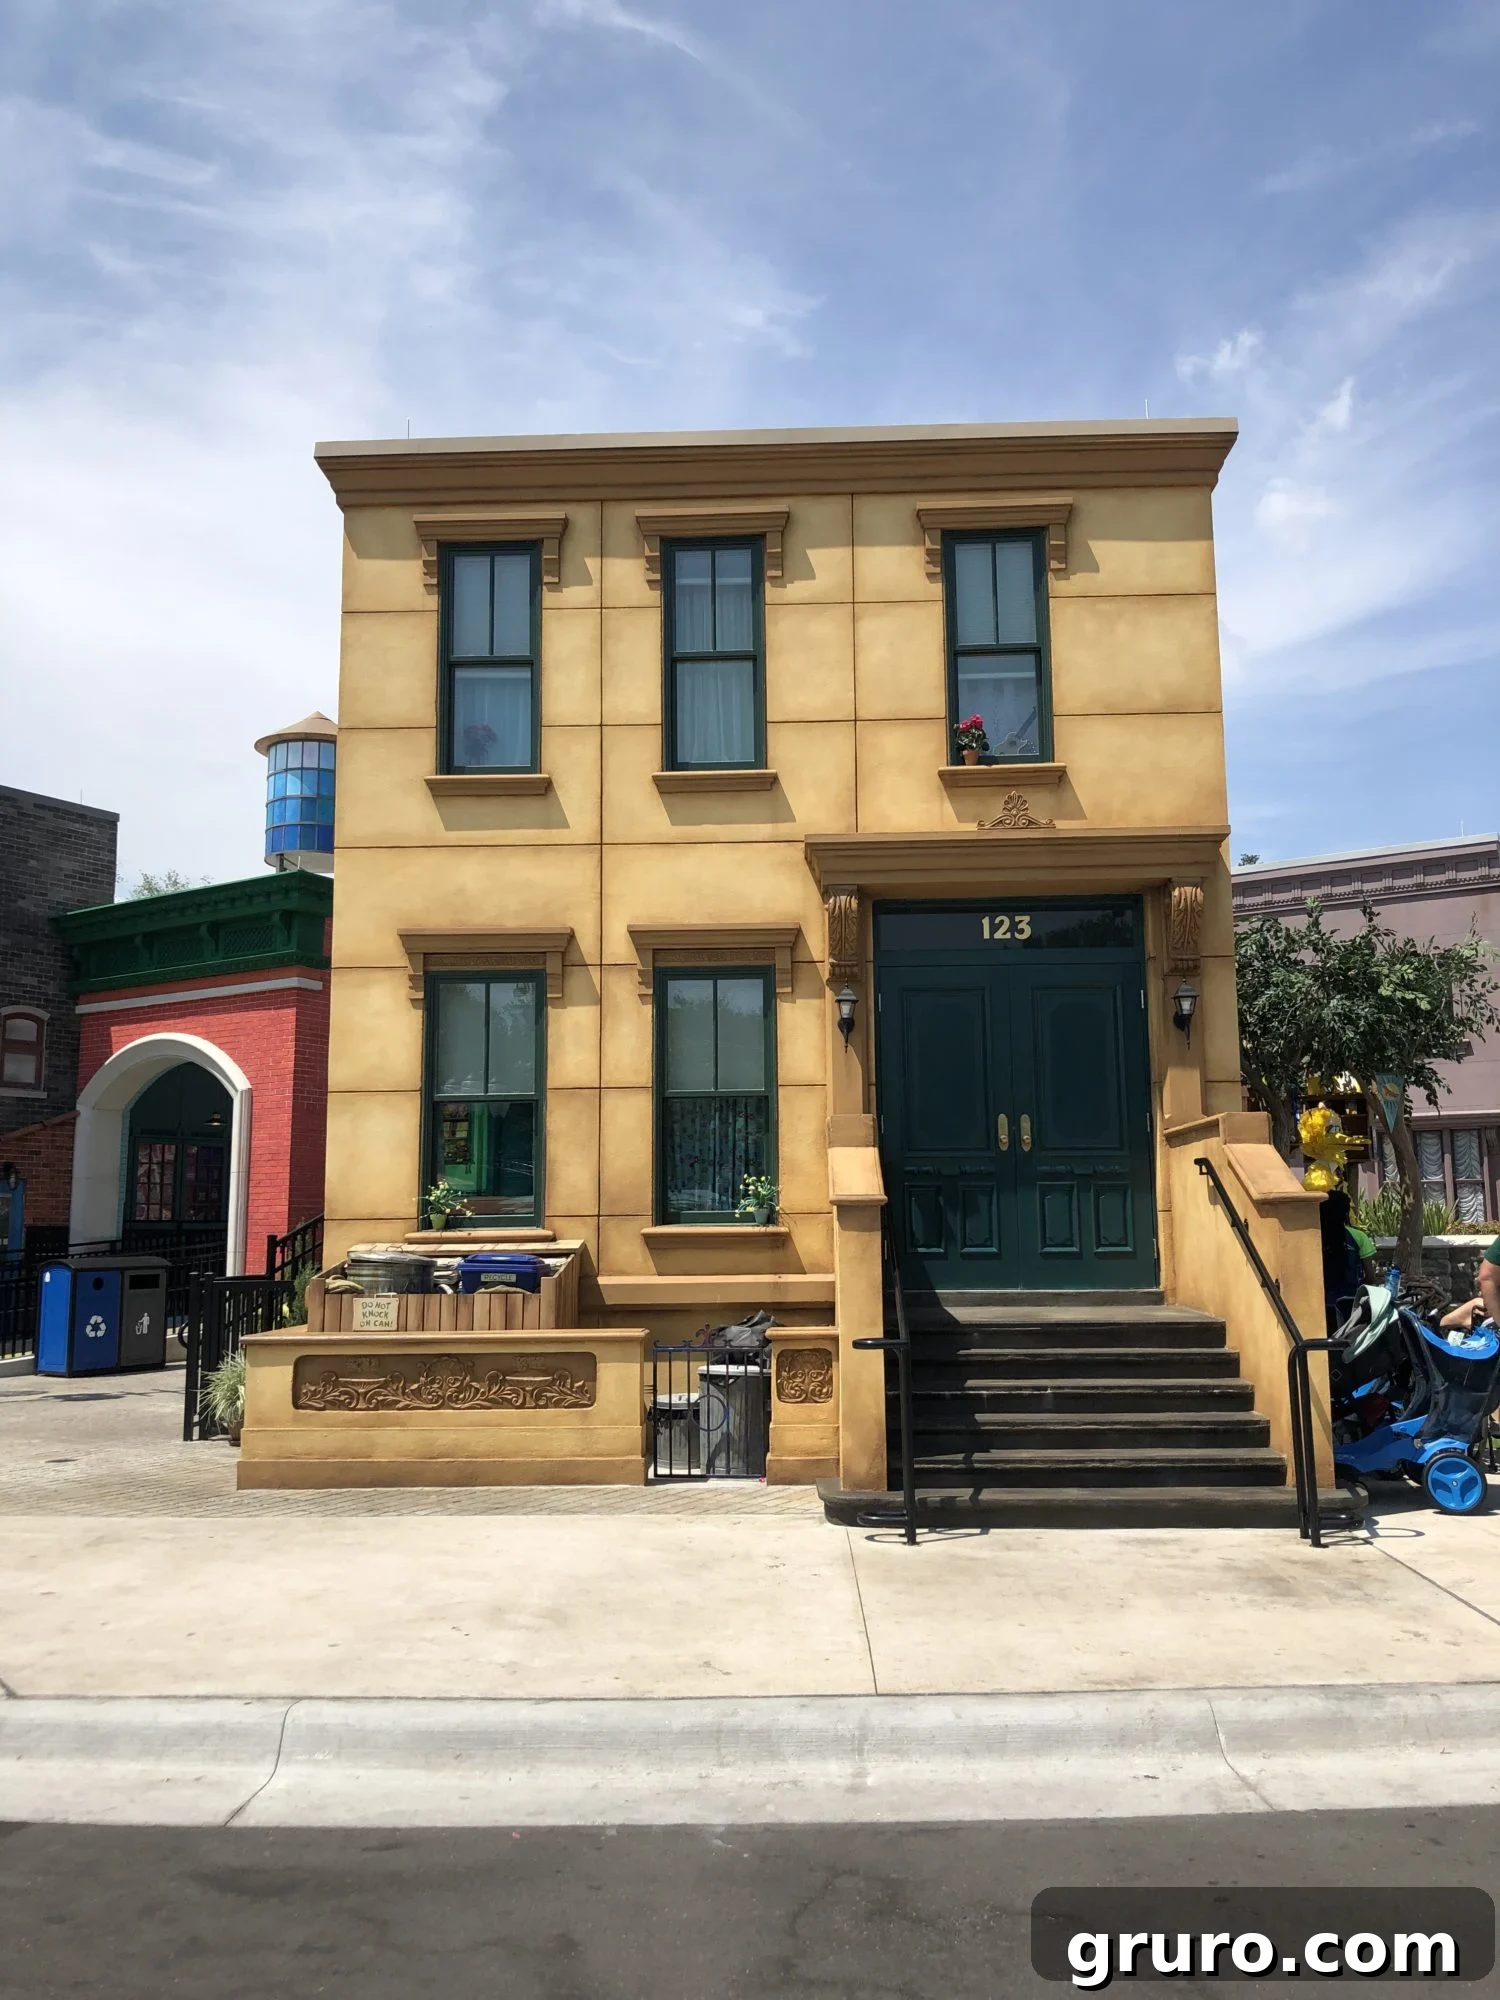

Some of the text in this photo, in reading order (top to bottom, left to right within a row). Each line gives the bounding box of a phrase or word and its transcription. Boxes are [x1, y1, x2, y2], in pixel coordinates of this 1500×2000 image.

[982, 915, 1031, 940] 123
[361, 1301, 391, 1310] DO NOT
[362, 1310, 389, 1319] KNOCK
[360, 1320, 393, 1328] ON CAN!
